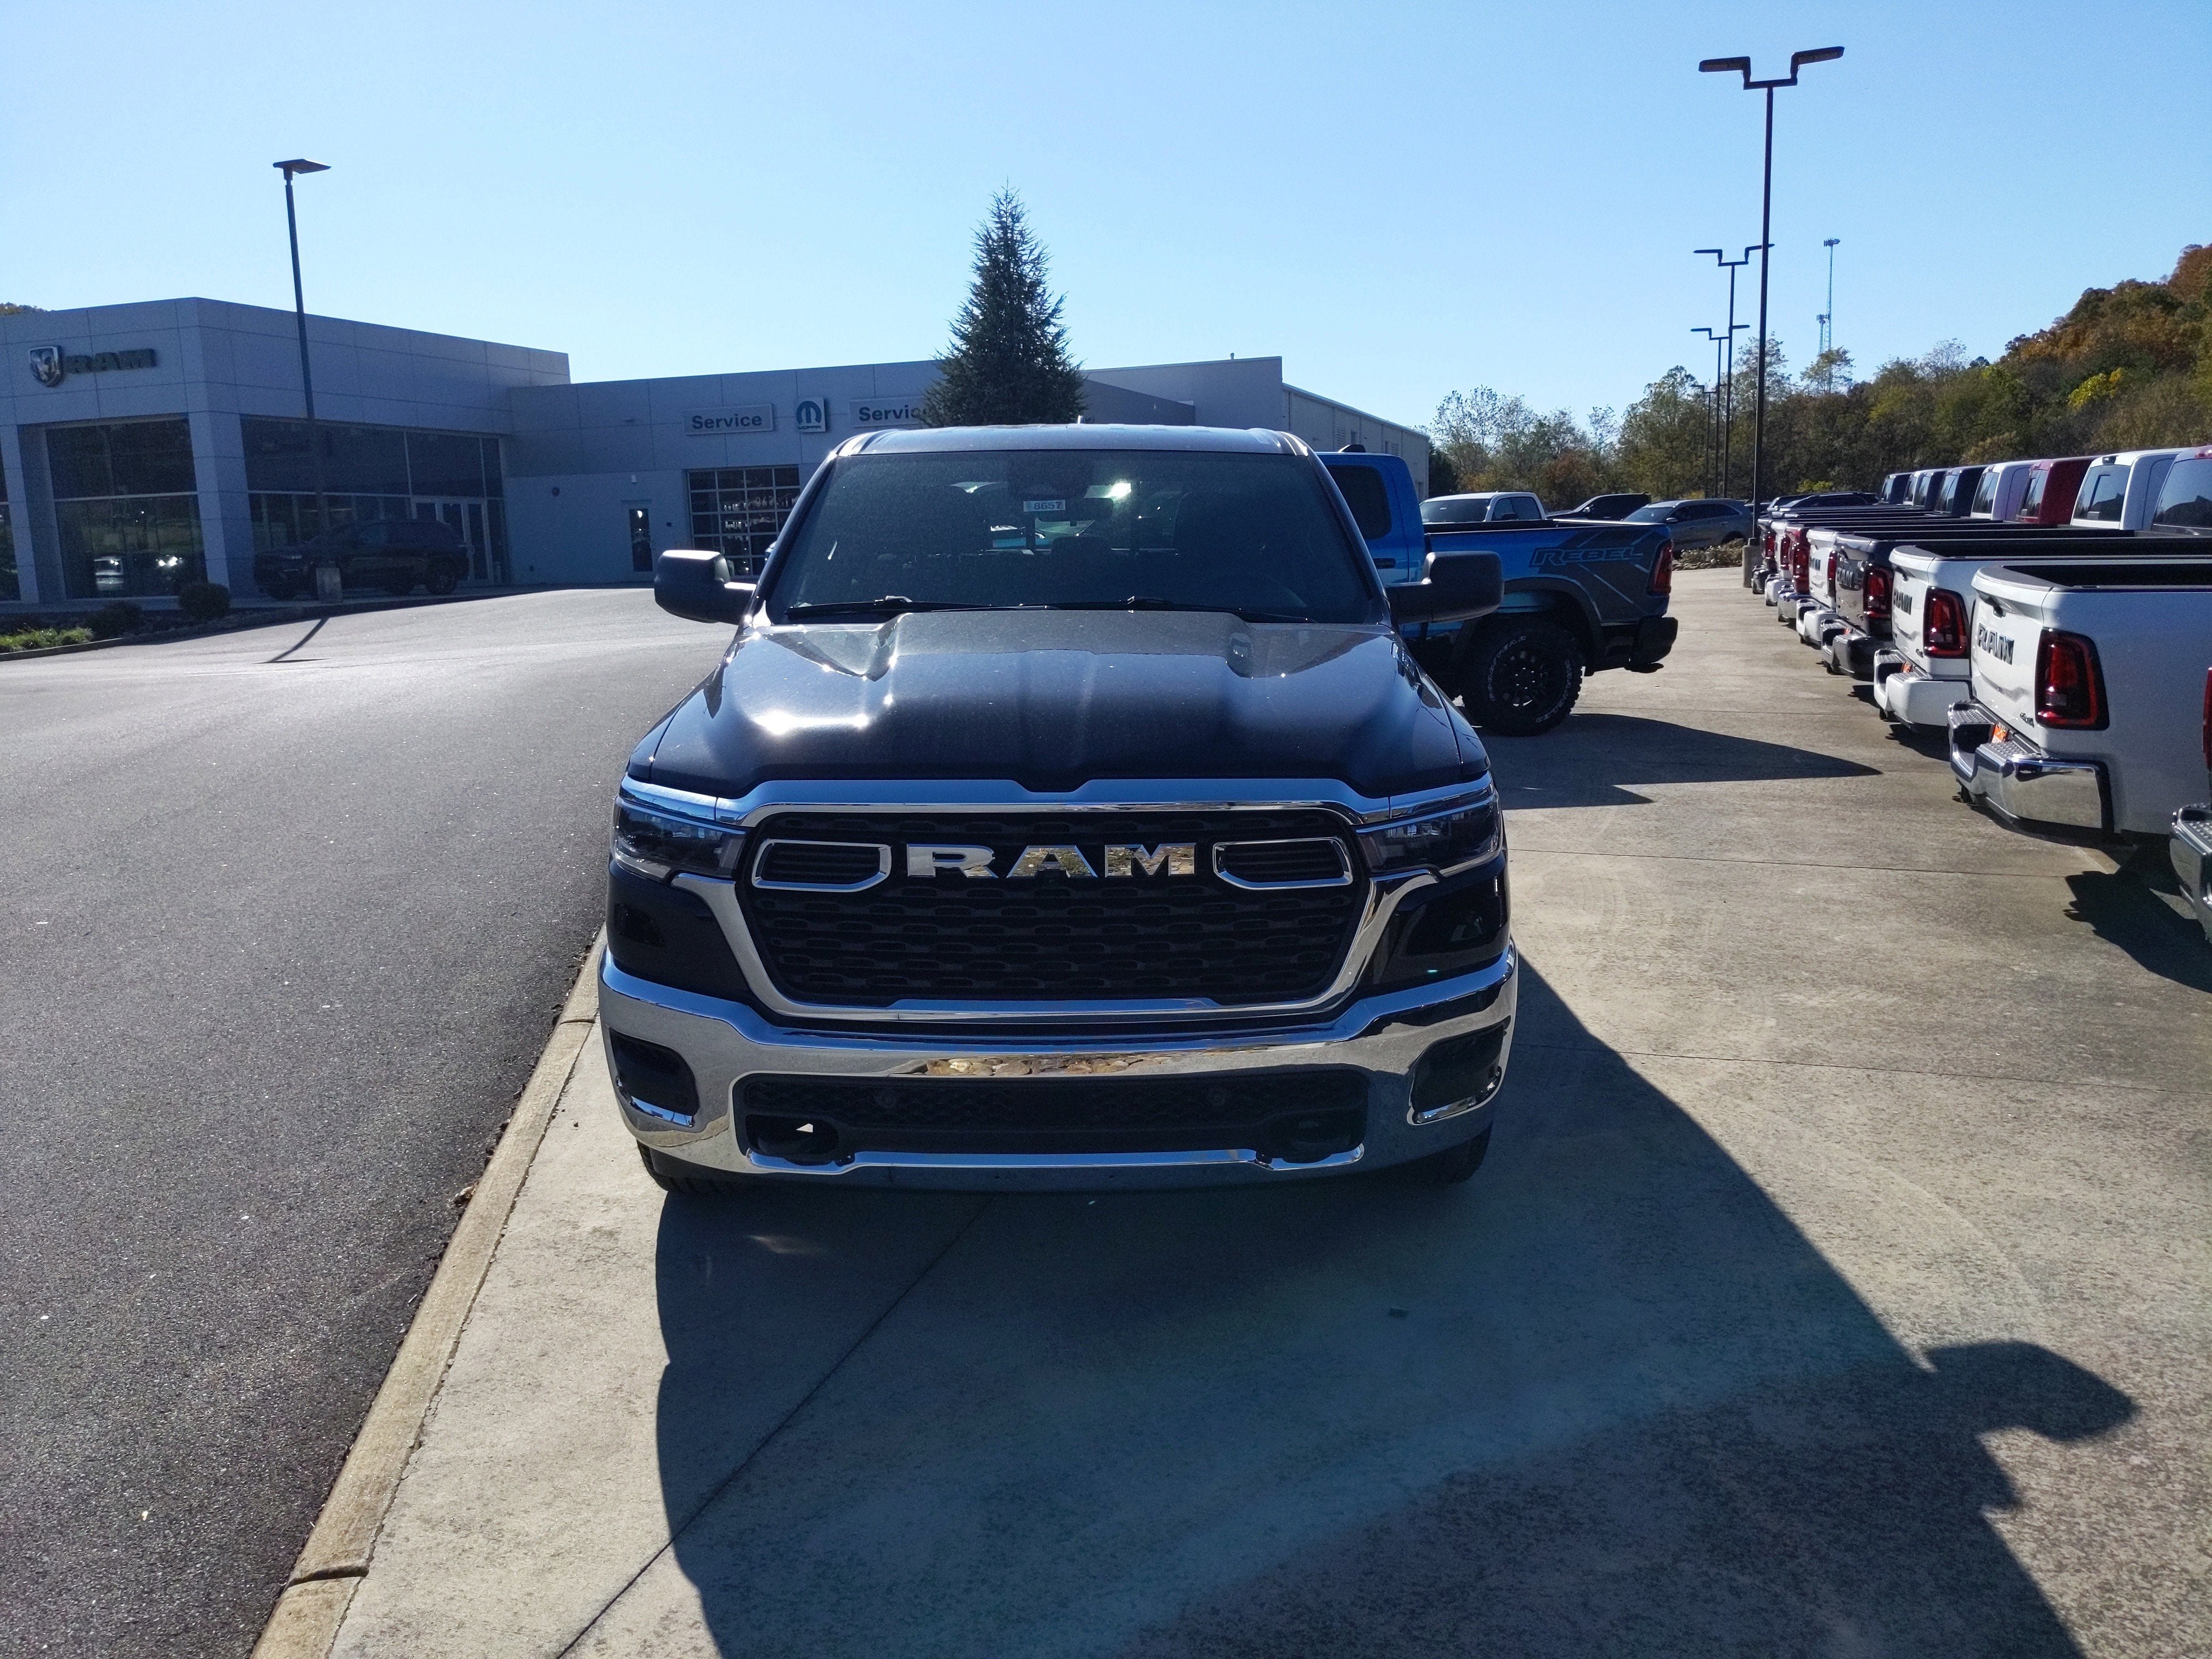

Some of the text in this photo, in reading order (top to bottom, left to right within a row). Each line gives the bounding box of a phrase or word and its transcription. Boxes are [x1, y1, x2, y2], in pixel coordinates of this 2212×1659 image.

[64, 348, 155, 373] RAM
[692, 414, 763, 429] Service
[859, 404, 927, 421] Servic
[1034, 501, 1063, 510] 8657
[1529, 547, 1645, 567] REBEL
[1893, 587, 1912, 616] RAM
[1977, 623, 2015, 665] RAM
[906, 843, 1197, 878] RAM
